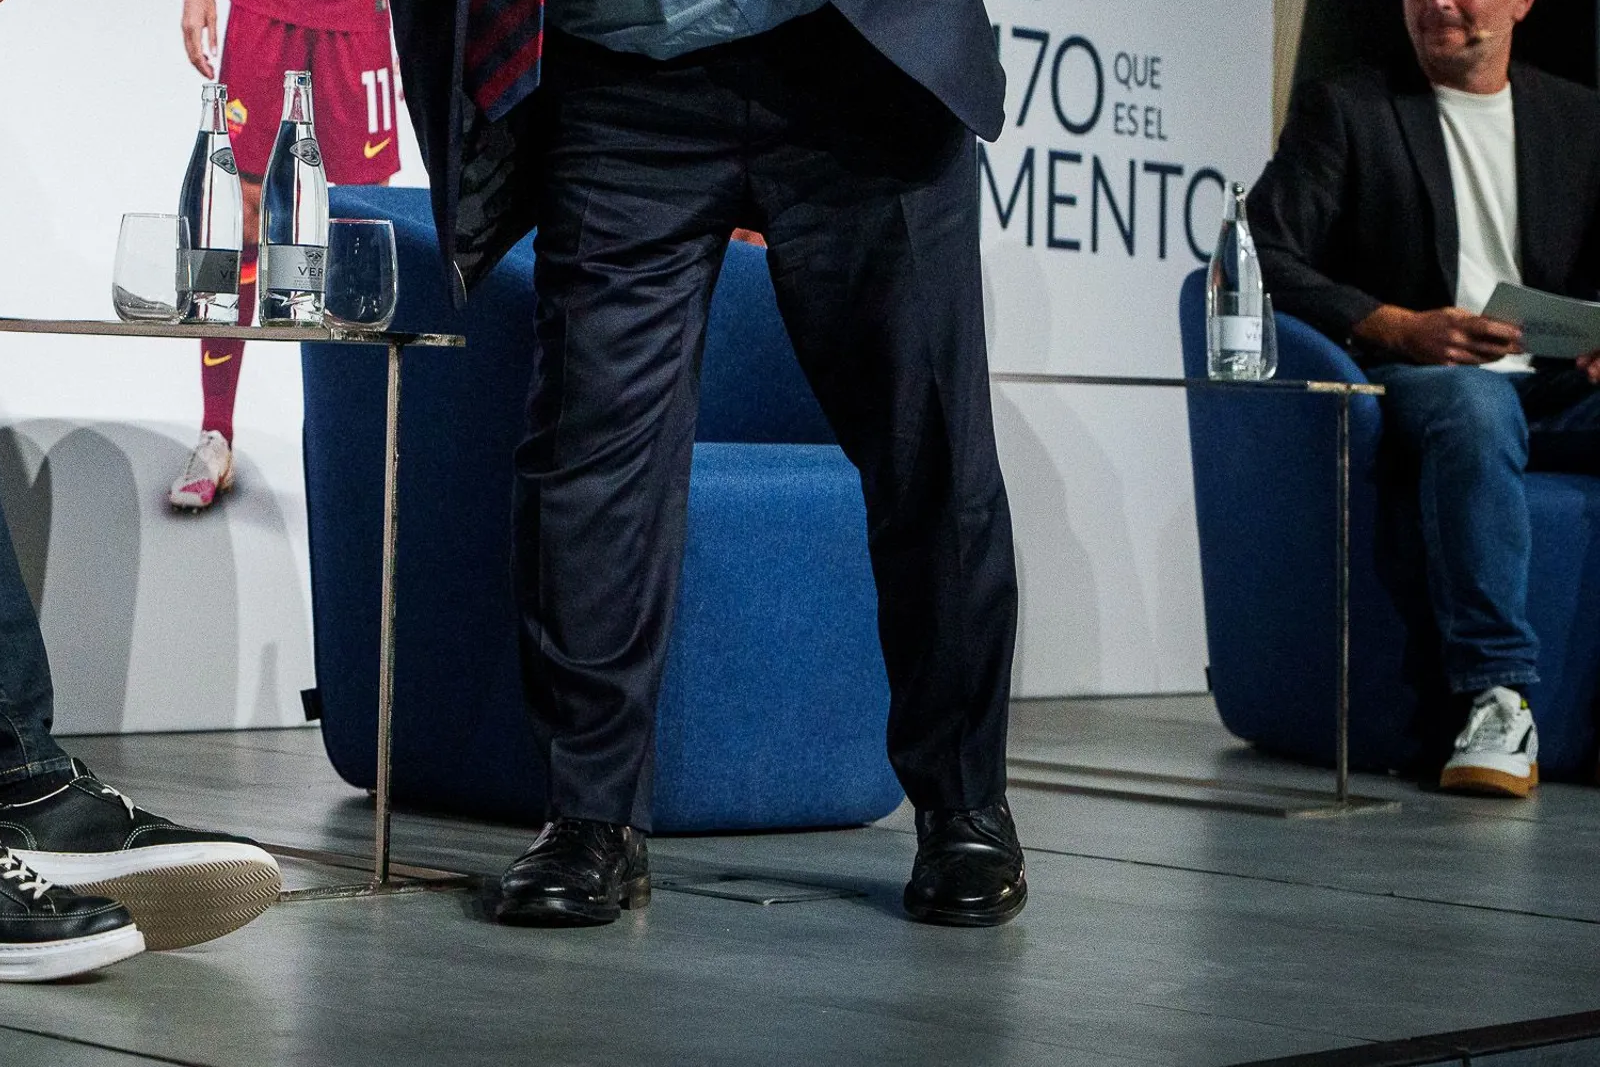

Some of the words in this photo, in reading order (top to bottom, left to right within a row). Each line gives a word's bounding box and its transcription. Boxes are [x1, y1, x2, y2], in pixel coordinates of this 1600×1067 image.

[992, 23, 1105, 135] 70
[1114, 52, 1161, 91] QUE
[361, 66, 392, 134] 11
[1114, 101, 1138, 136] ES
[1144, 105, 1168, 141] EL
